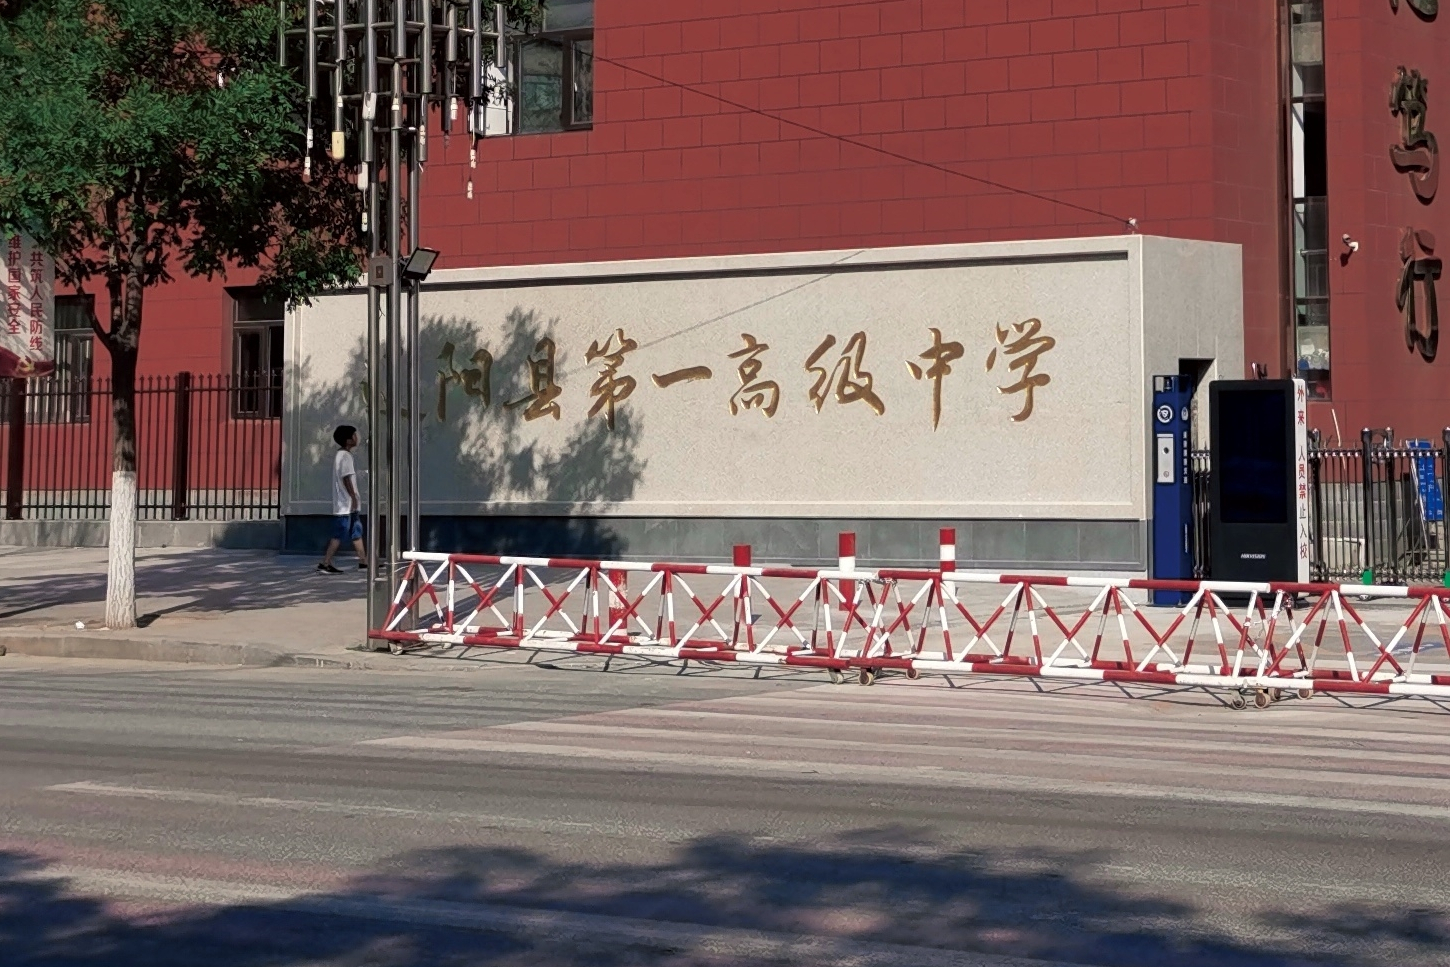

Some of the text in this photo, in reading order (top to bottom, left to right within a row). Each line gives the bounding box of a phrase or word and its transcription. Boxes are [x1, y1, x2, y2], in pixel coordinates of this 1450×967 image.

[7, 234, 22, 335] 维护国家安全
[29, 251, 44, 350] 共筑人民防线
[360, 317, 1057, 432] 阳县第一高级中学
[1297, 384, 1308, 559] 外来人员禁止入校
